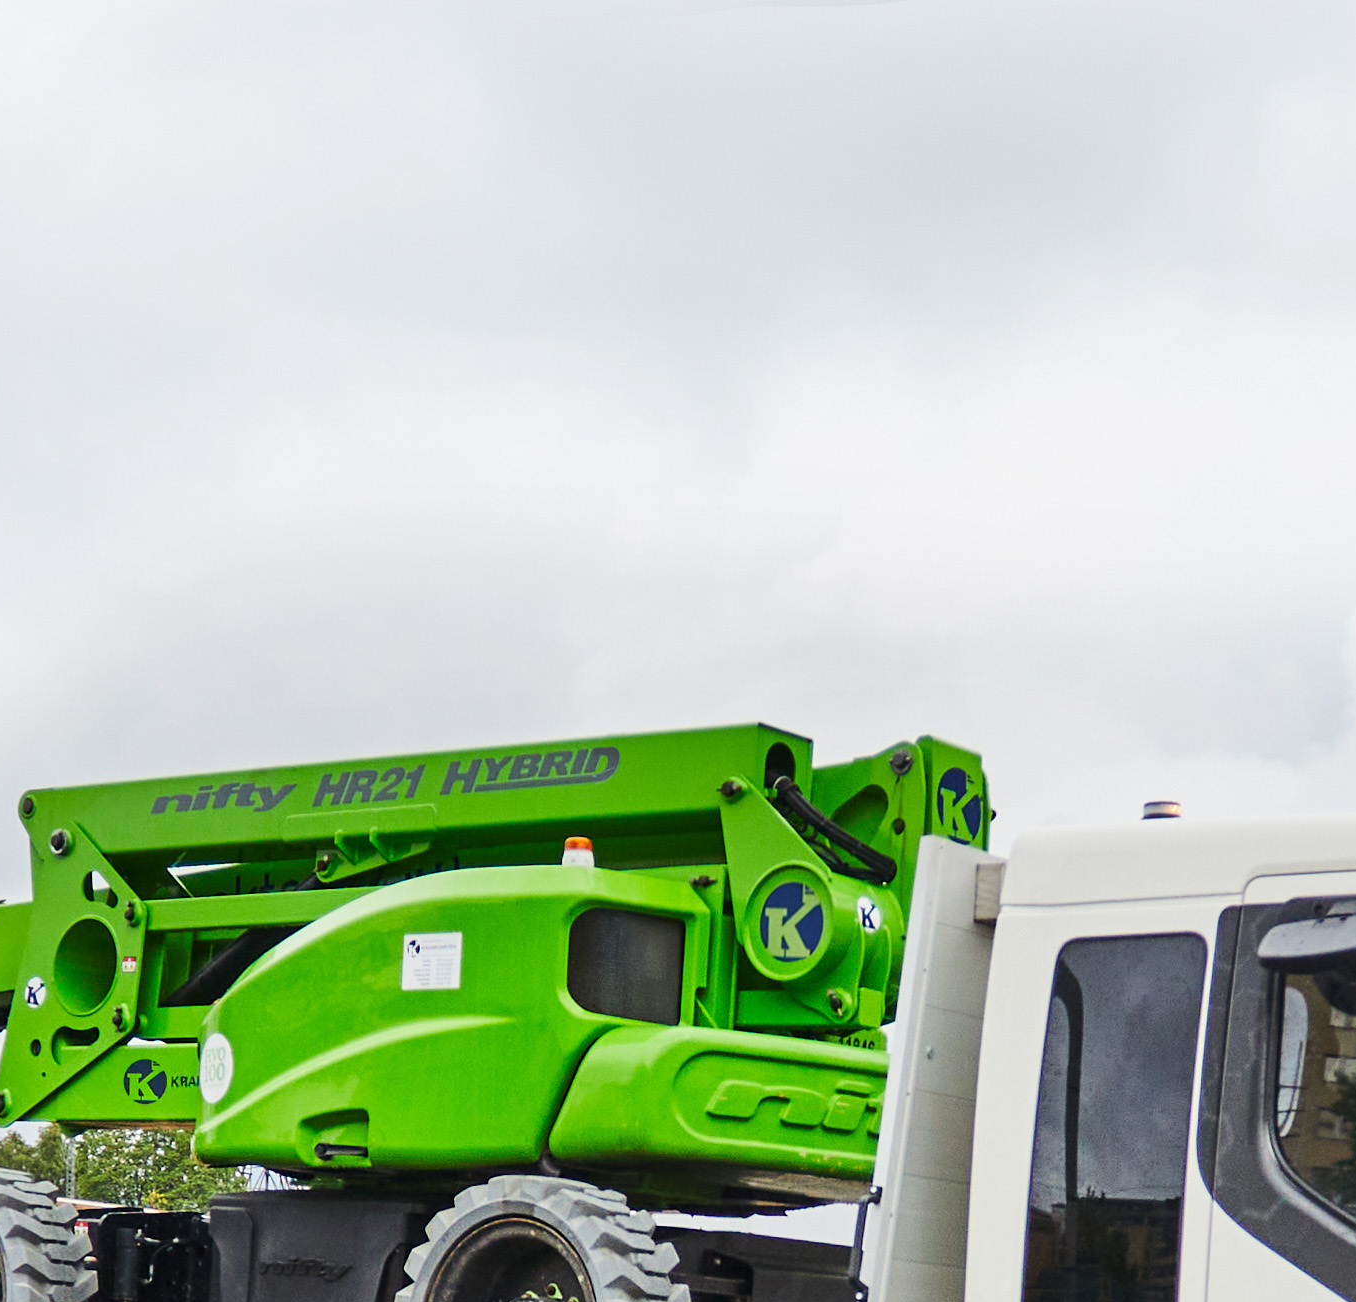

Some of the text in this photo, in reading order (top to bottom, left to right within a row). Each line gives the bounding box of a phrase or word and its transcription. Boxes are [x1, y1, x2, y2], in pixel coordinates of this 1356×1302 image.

[150, 746, 621, 814] nifty HR21 HYBRID
